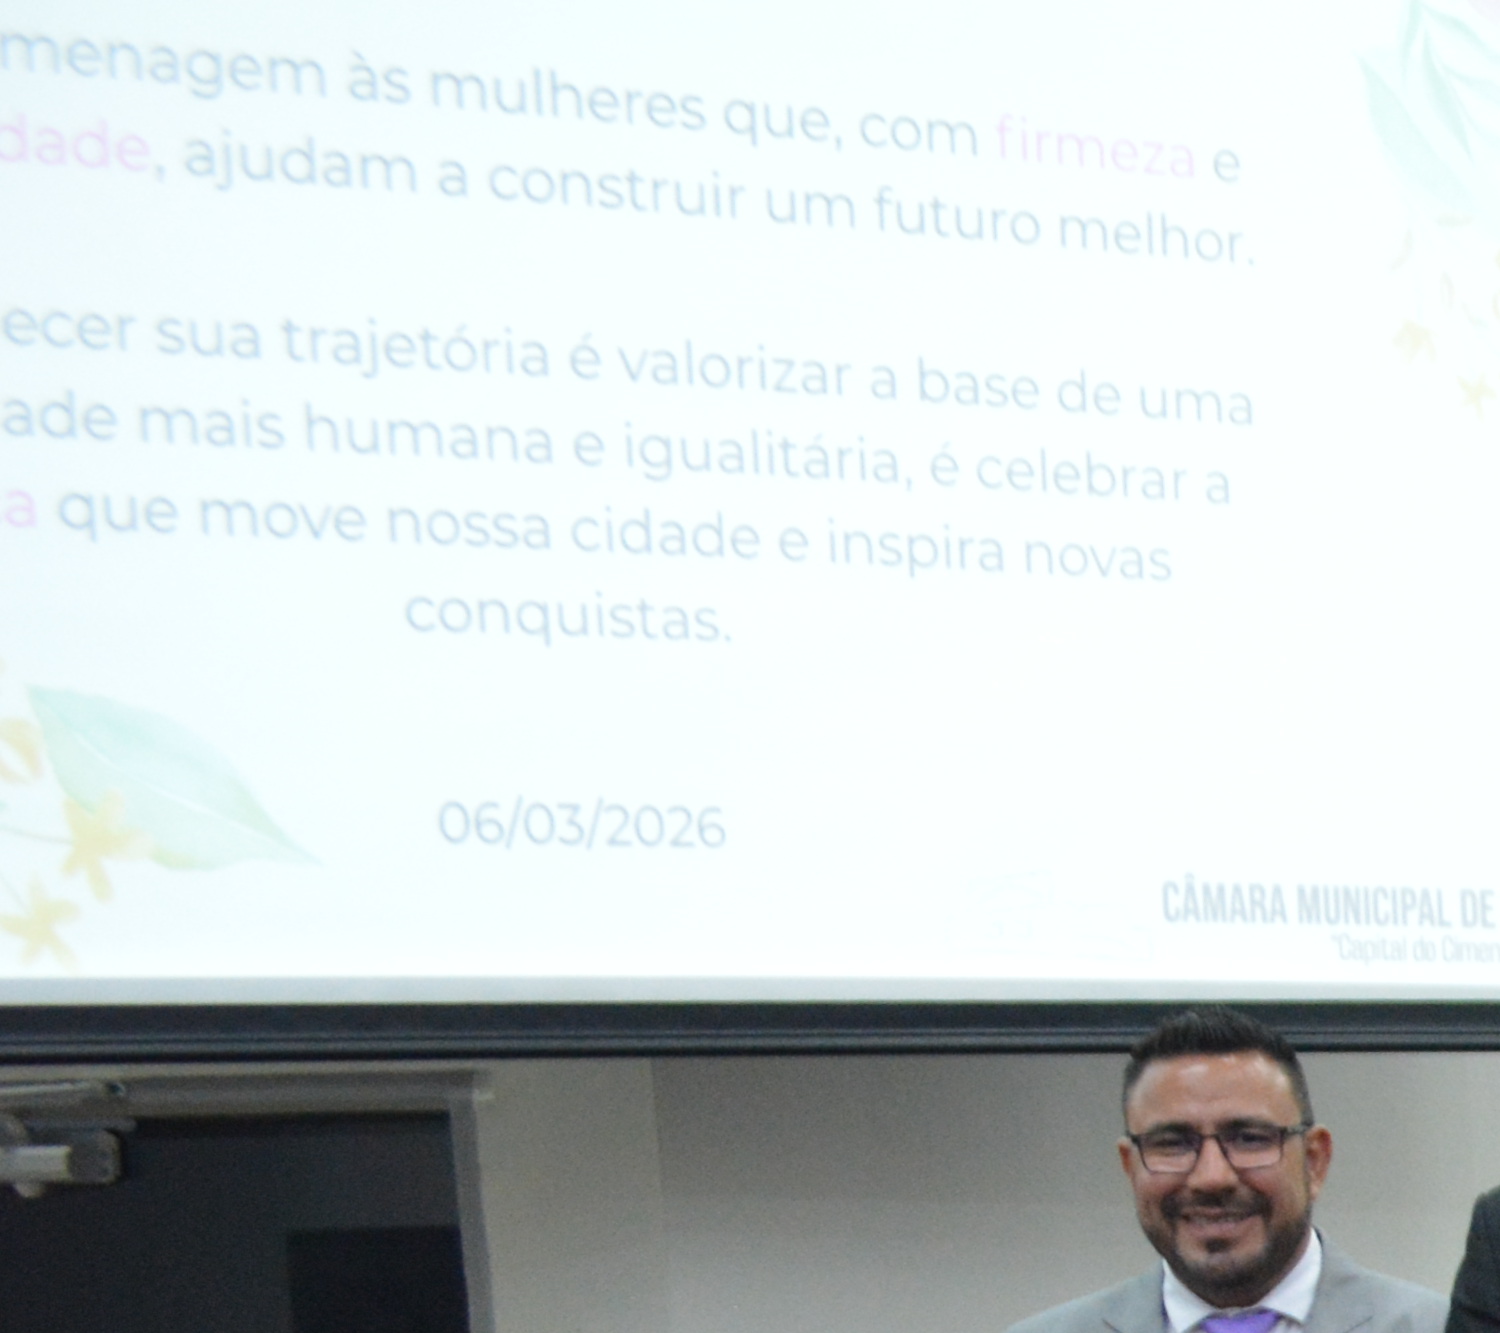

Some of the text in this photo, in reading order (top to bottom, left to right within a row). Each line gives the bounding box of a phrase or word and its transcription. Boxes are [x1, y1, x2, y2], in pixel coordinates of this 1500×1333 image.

[348, 50, 412, 105] às
[431, 67, 707, 131] mulheres
[724, 97, 844, 151] que,
[860, 112, 979, 157] com
[995, 112, 1195, 178] firmeza
[1213, 148, 1241, 184] e
[184, 128, 418, 192] ajudam
[438, 160, 468, 198] a
[490, 163, 746, 220] construir
[766, 186, 856, 231] um
[875, 185, 1041, 246] futuro
[1060, 211, 1255, 267] melhor.
[157, 315, 262, 360] sua
[281, 317, 551, 379] trajetória
[570, 331, 602, 381] é
[619, 340, 852, 397] valorizar
[870, 363, 898, 400] a
[918, 355, 1041, 409] base
[1056, 368, 1122, 416] de
[1140, 383, 1254, 426] uma
[138, 398, 287, 450] mais
[304, 401, 554, 464] humana
[573, 431, 605, 467] e
[624, 420, 913, 493] igualitária,
[930, 441, 960, 486] é
[976, 447, 1188, 501] celebrar
[1205, 470, 1231, 504] a
[58, 490, 179, 543] que
[200, 497, 368, 542] move
[387, 506, 553, 551] nossa
[571, 506, 761, 559] cidade
[778, 525, 810, 563] e
[827, 517, 1004, 578] inspira
[1024, 539, 1173, 582] novas
[404, 591, 733, 649] conquistas.
[438, 794, 726, 850] 06/03/2026
[1162, 870, 1288, 925] CÂMARA
[1297, 883, 1451, 928] MUNICIPAL
[1460, 889, 1494, 929] DE
[1412, 936, 1437, 964] do
